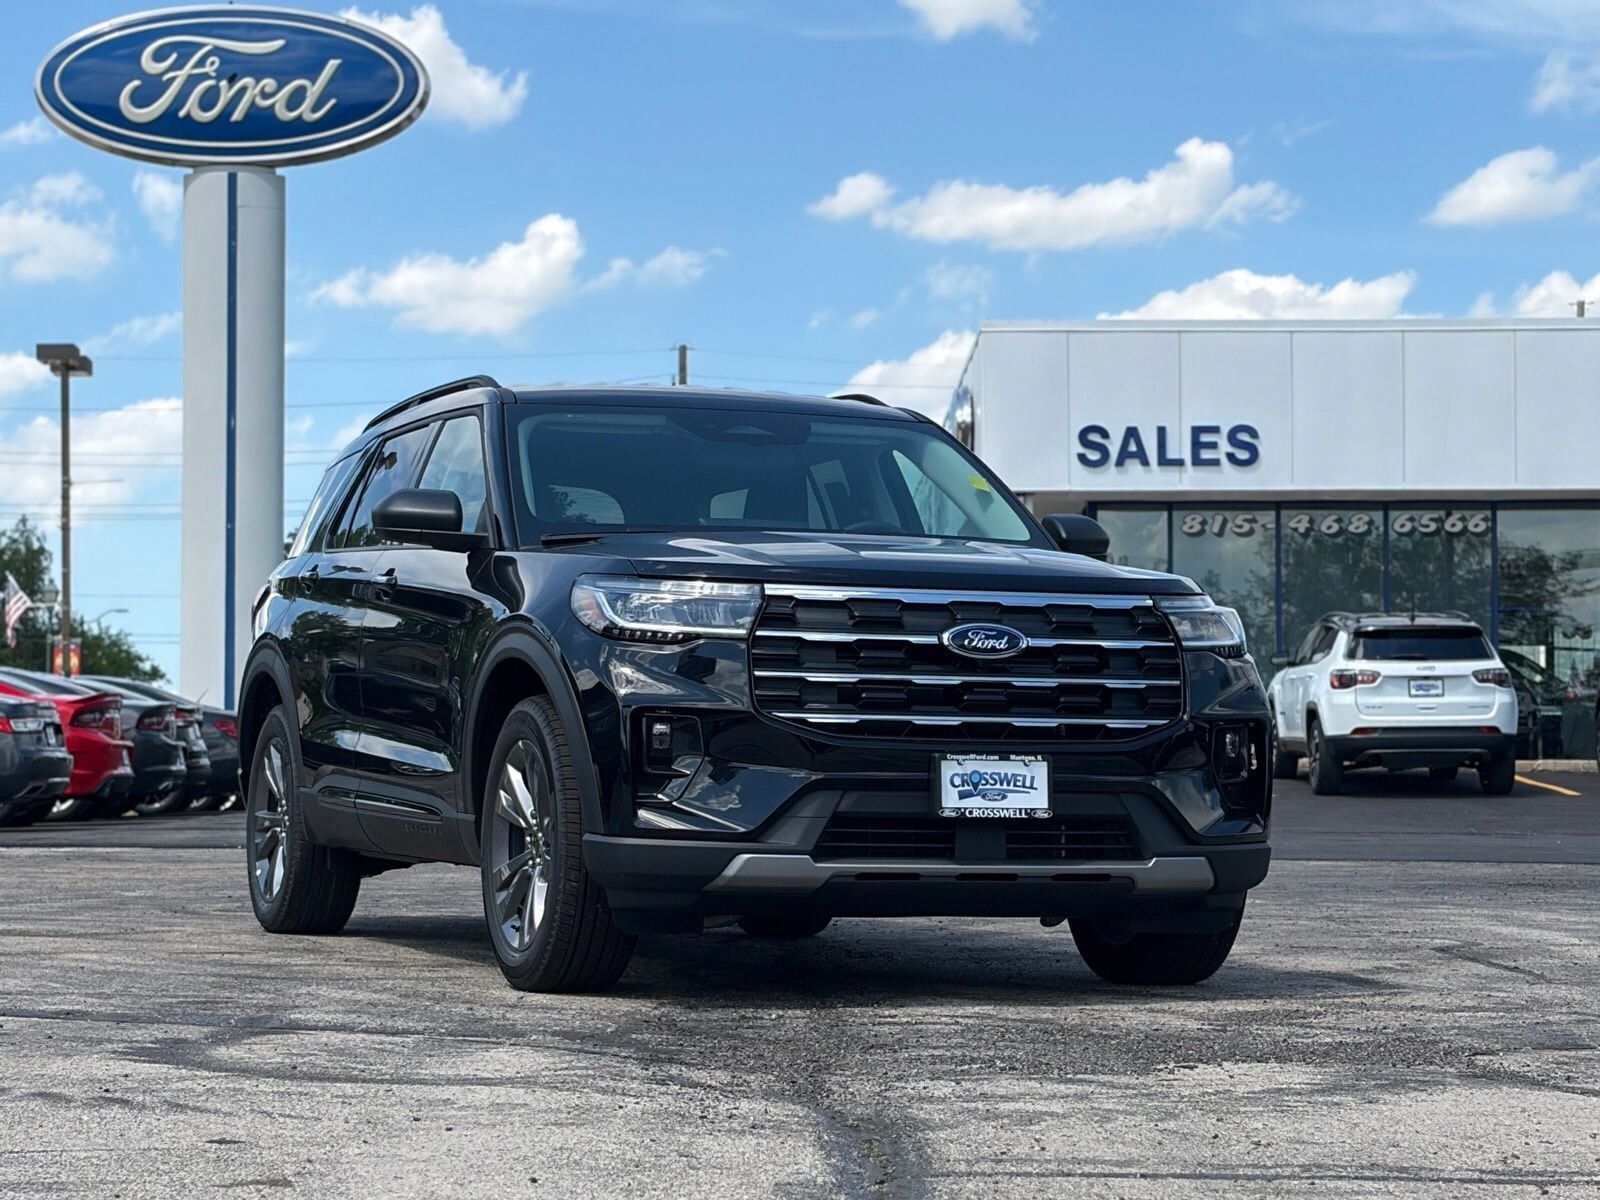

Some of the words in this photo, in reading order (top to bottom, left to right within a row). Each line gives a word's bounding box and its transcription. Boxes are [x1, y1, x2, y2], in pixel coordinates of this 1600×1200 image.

[118, 34, 342, 125] Ford
[1076, 424, 1260, 469] SALES
[1393, 513, 1491, 536] 6566
[964, 629, 1009, 650] Ford
[965, 808, 1028, 818] CROSSWELL
